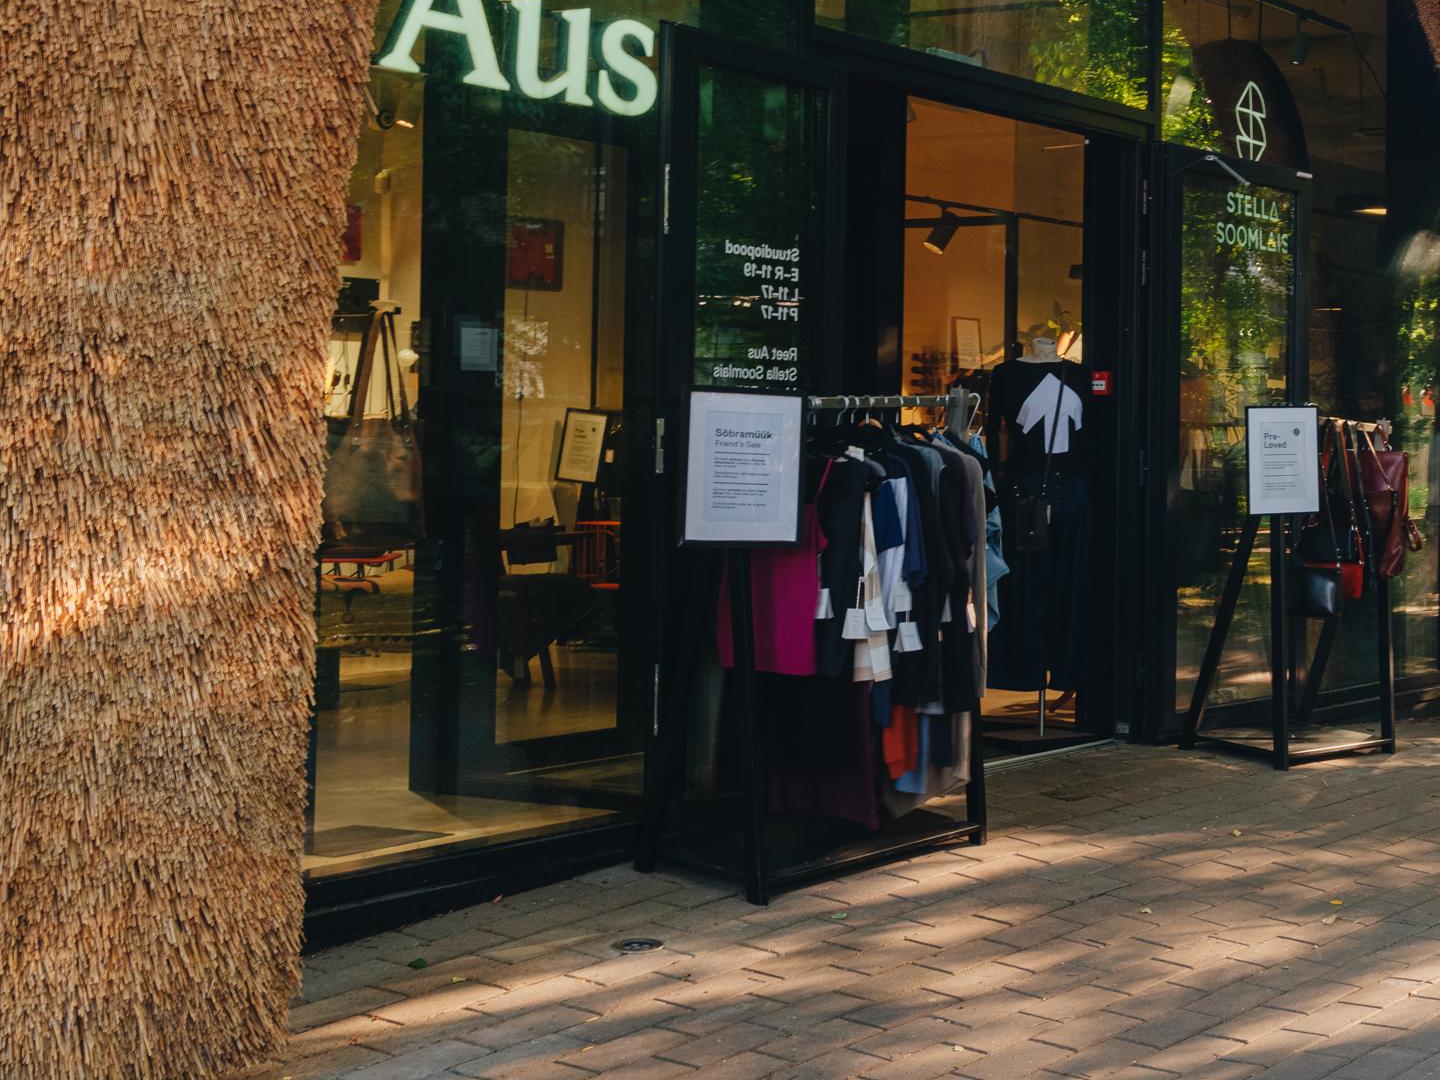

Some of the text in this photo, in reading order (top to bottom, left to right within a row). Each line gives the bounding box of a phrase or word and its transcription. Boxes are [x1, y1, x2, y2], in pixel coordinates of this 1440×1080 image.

[1226, 191, 1280, 221] STELLA
[1216, 221, 1289, 254] SOOMLAIS
[1264, 441, 1287, 449] Loved
